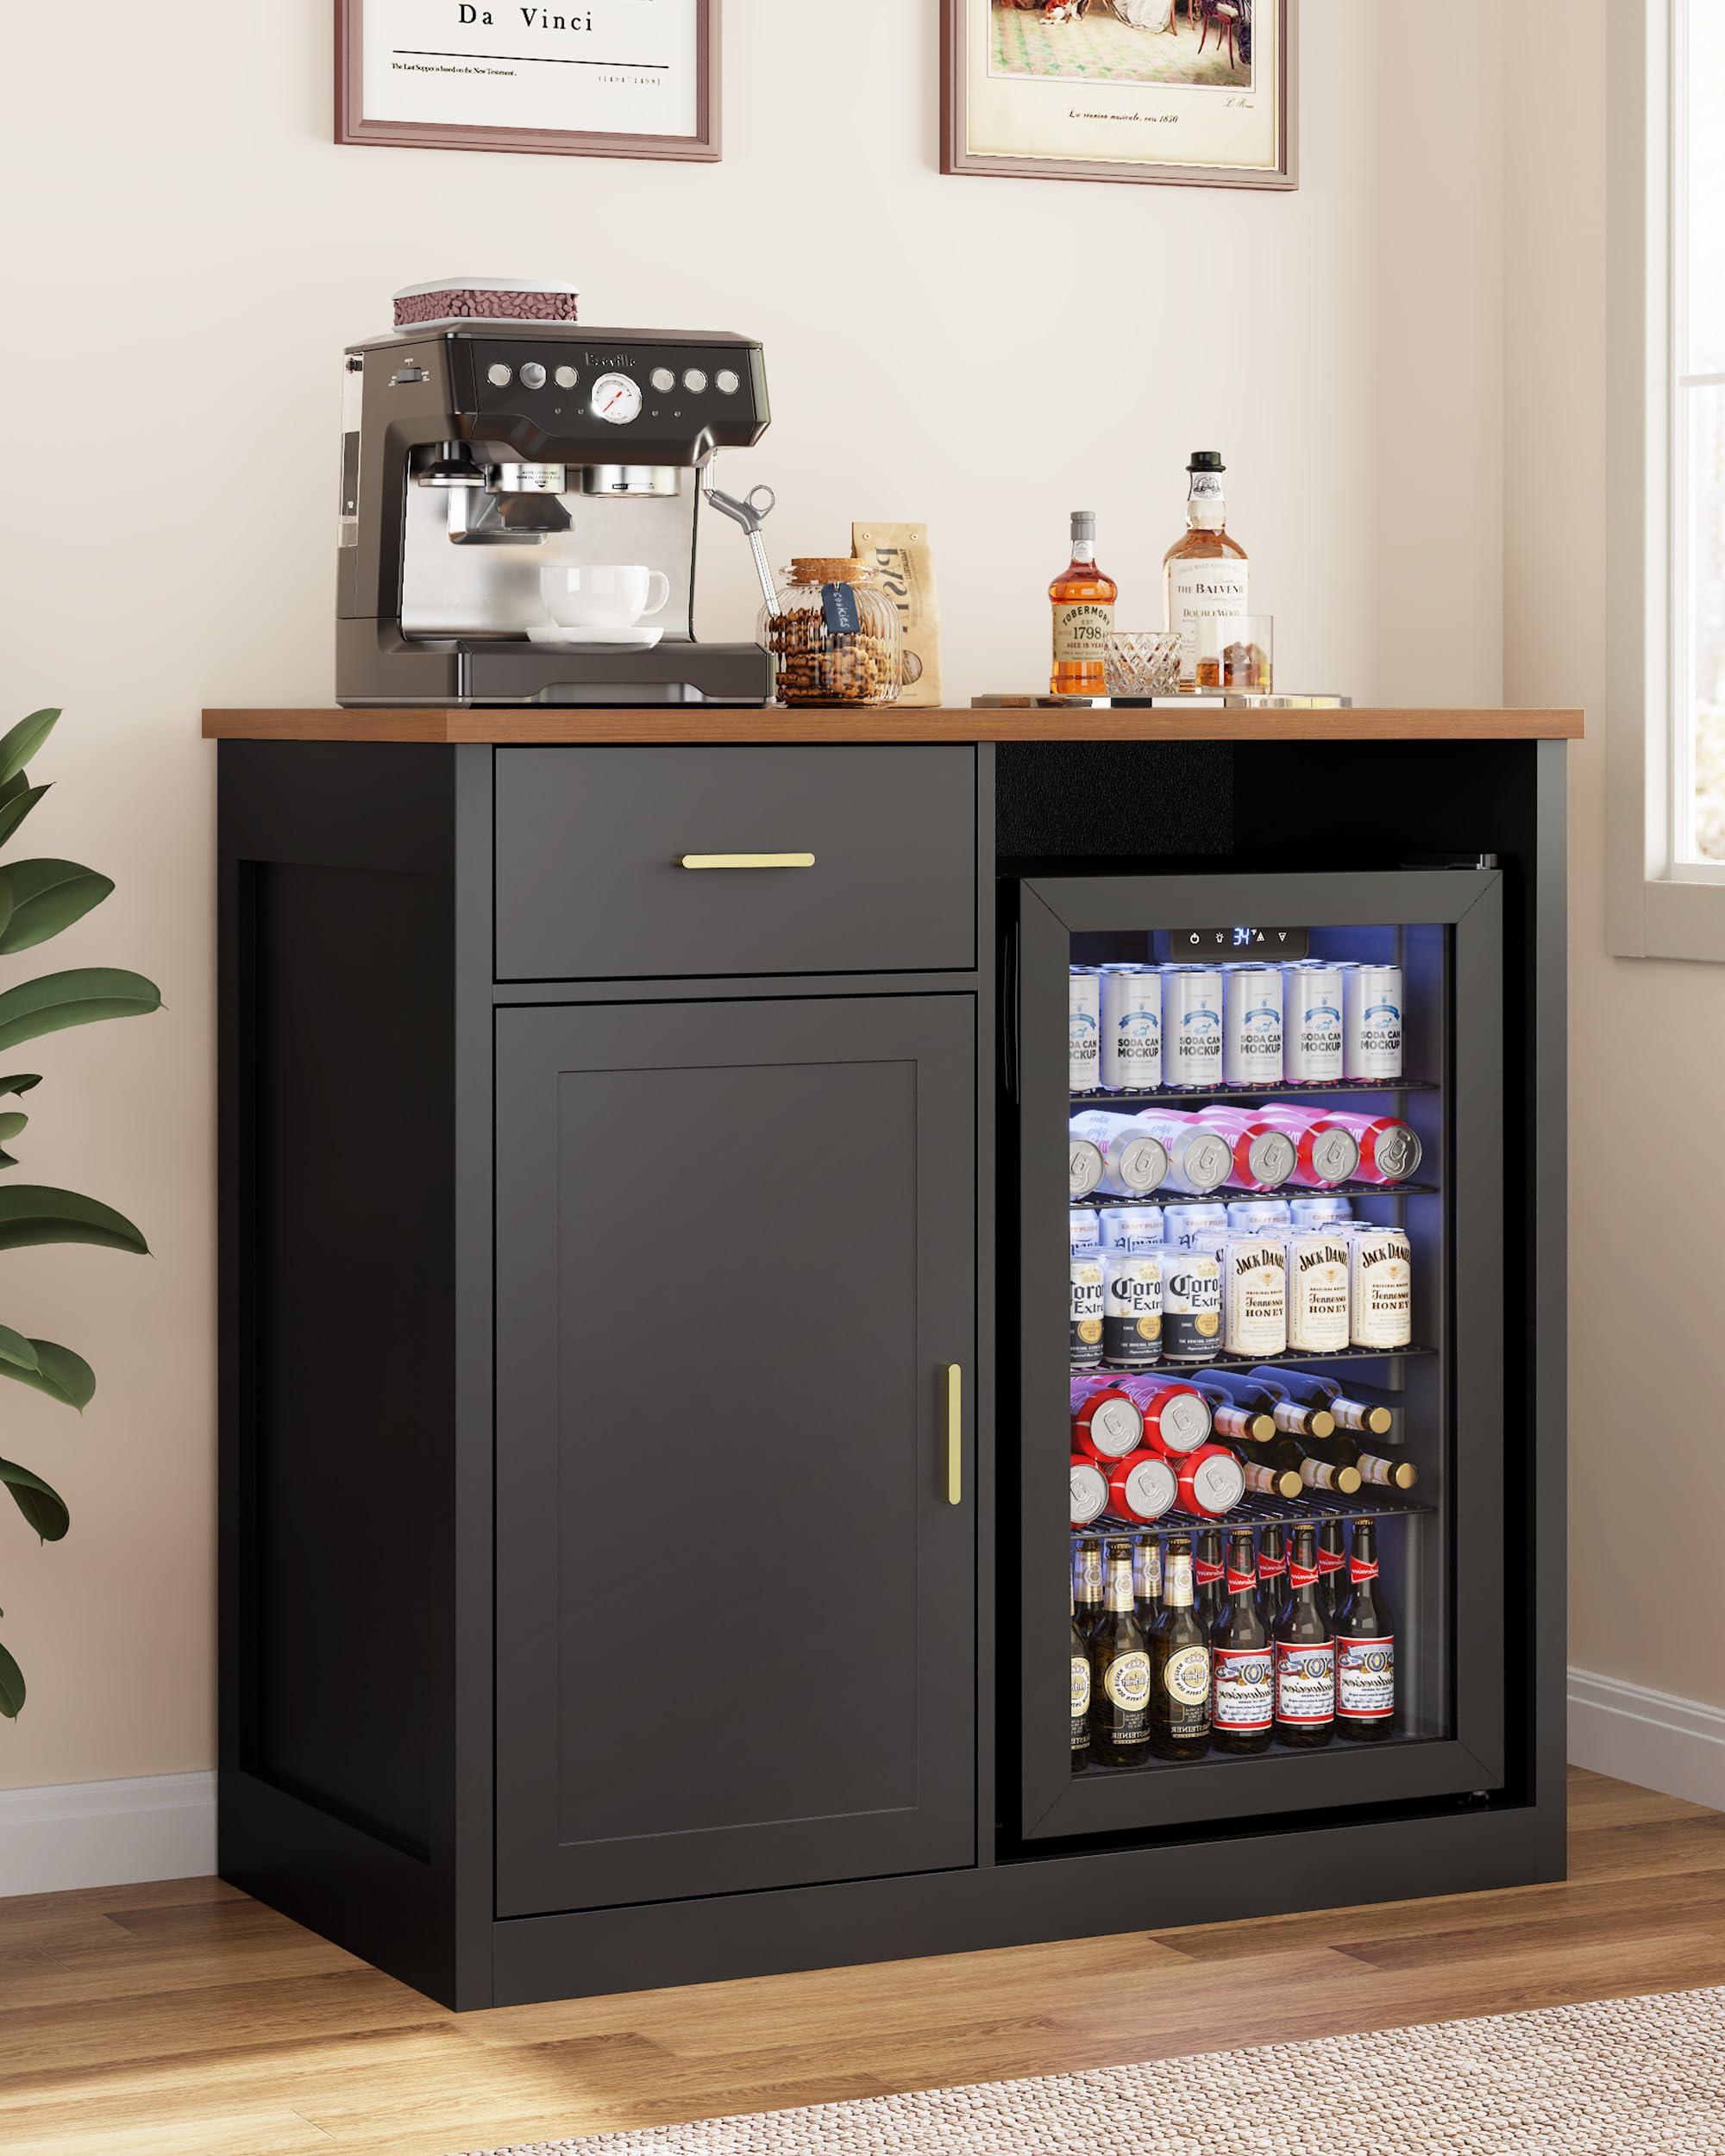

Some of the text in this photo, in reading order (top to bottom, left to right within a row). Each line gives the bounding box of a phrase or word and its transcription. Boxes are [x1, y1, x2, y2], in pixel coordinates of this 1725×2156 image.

[459, 3, 592, 31] Da Vinci
[416, 64, 435, 72] Supper
[1158, 115, 1178, 123] 1850
[1063, 605, 1110, 626] TOBERMORY
[1074, 627, 1101, 640] 1798
[1233, 928, 1250, 945] 34
[1118, 1038, 1159, 1047] SODA CAN
[1208, 1036, 1220, 1044] CAN
[1360, 1040, 1401, 1050] MOCKUP
[1118, 1047, 1158, 1057] MOCKUP
[1179, 1045, 1220, 1056] MOCKUP
[1240, 1044, 1280, 1054] MOCKUP
[1301, 1042, 1340, 1052] MOCKUP
[1300, 1250, 1324, 1272] JACK
[1363, 1247, 1387, 1269] JACK
[1236, 1254, 1261, 1275] JACK
[1372, 1300, 1409, 1309] HONEY
[1245, 1308, 1283, 1317] HONEY
